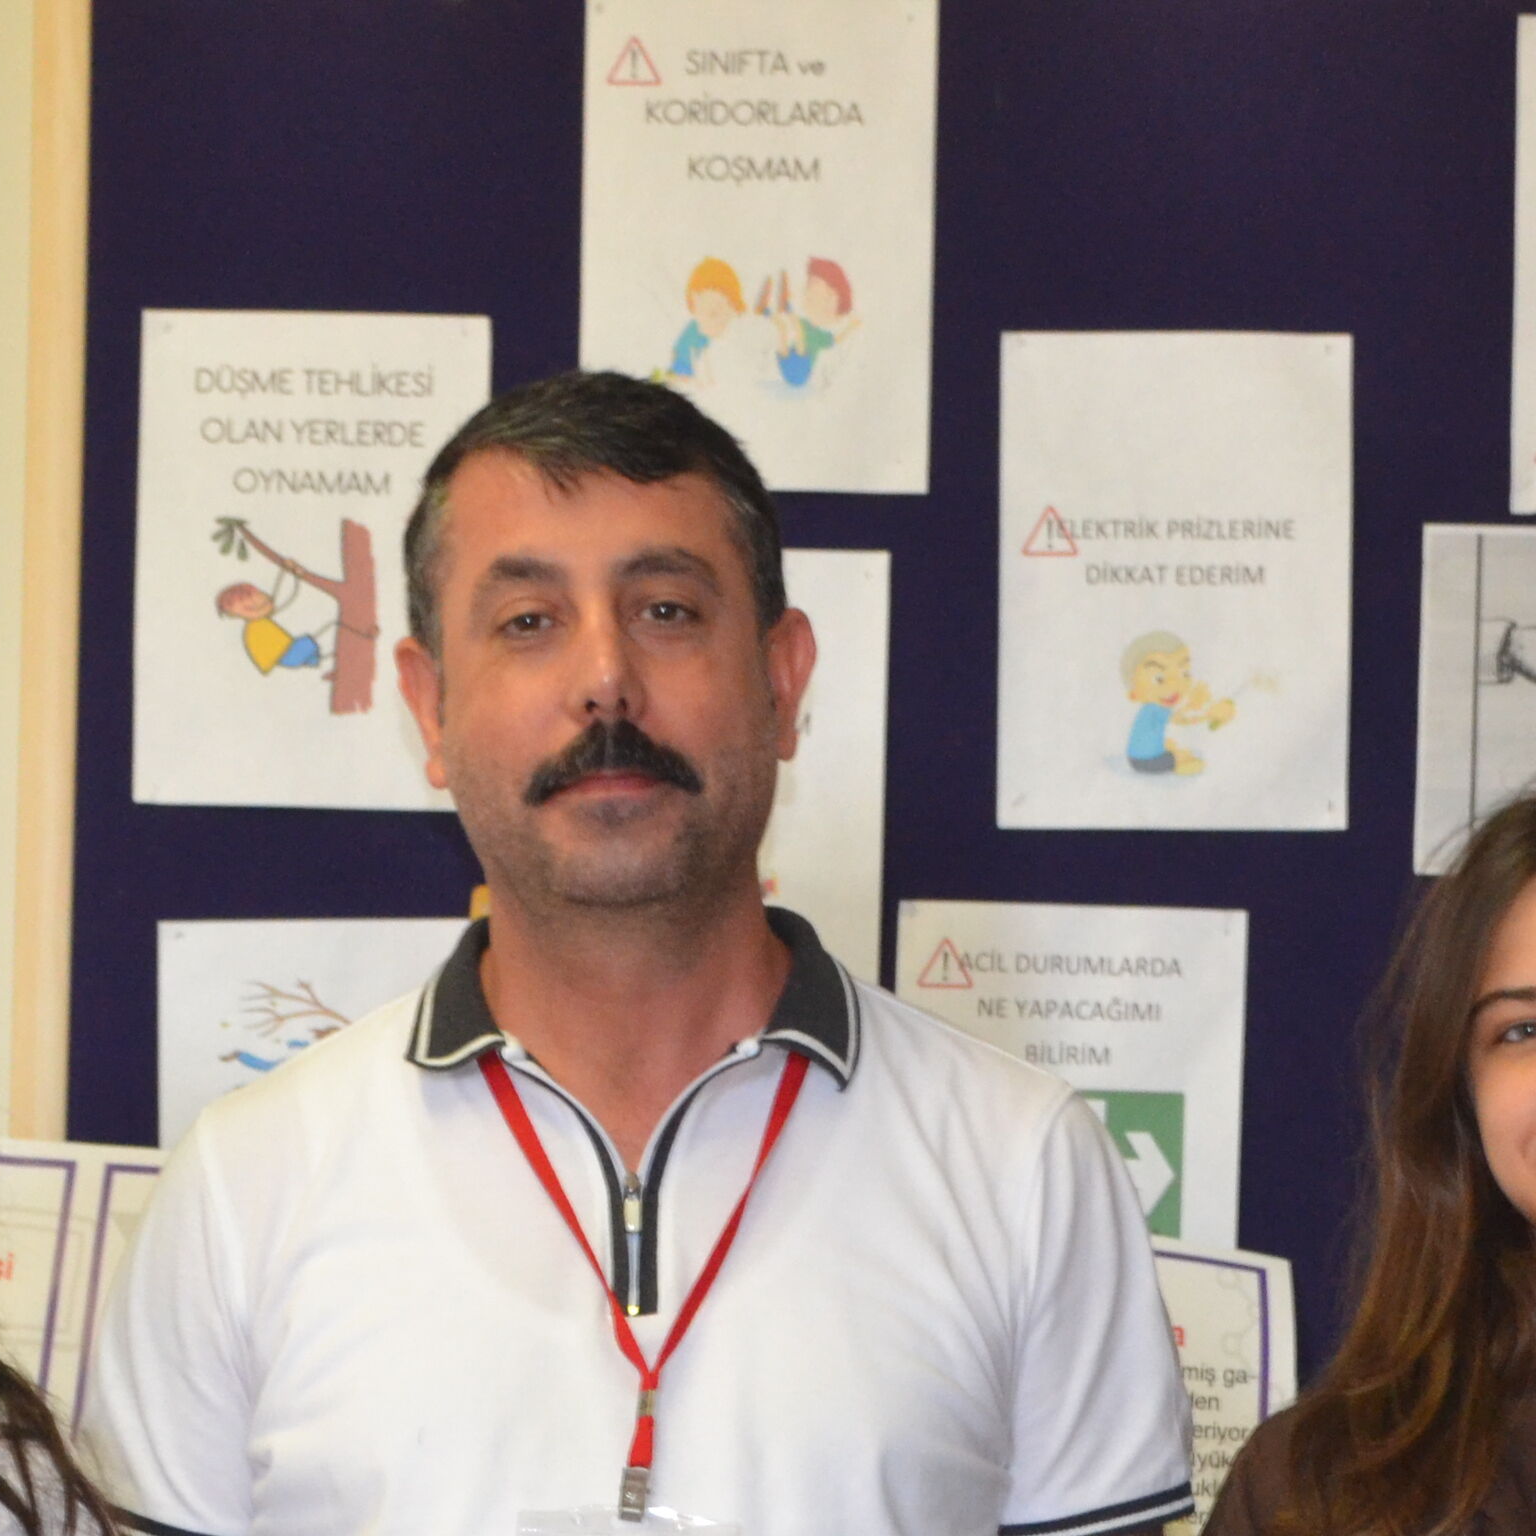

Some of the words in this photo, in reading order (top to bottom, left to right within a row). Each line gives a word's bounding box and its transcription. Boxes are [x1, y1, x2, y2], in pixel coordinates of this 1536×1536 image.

[685, 49, 788, 77] SINIFTA
[797, 58, 826, 76] ve
[645, 93, 863, 128] KORİDORLARDA
[688, 155, 820, 187] KOŞMAM
[195, 363, 293, 401] DÜŞME
[304, 366, 433, 397] TEHLİKESİ
[200, 418, 288, 445] OLAN
[291, 420, 425, 448] YERLERDE
[233, 468, 390, 495] OYNAMAM
[1056, 515, 1159, 541] ELEKTRİK
[1167, 515, 1295, 541] PRİZLERİNE
[1085, 561, 1167, 585] DİKKAT
[1175, 561, 1264, 585] EDERİM
[959, 950, 1008, 974] ACİL
[1016, 953, 1182, 977] DURUMLARDA
[978, 999, 1009, 1018] NE
[1017, 998, 1162, 1022] YAPACAĞIMI
[1025, 1042, 1111, 1066] BİLİRİM
